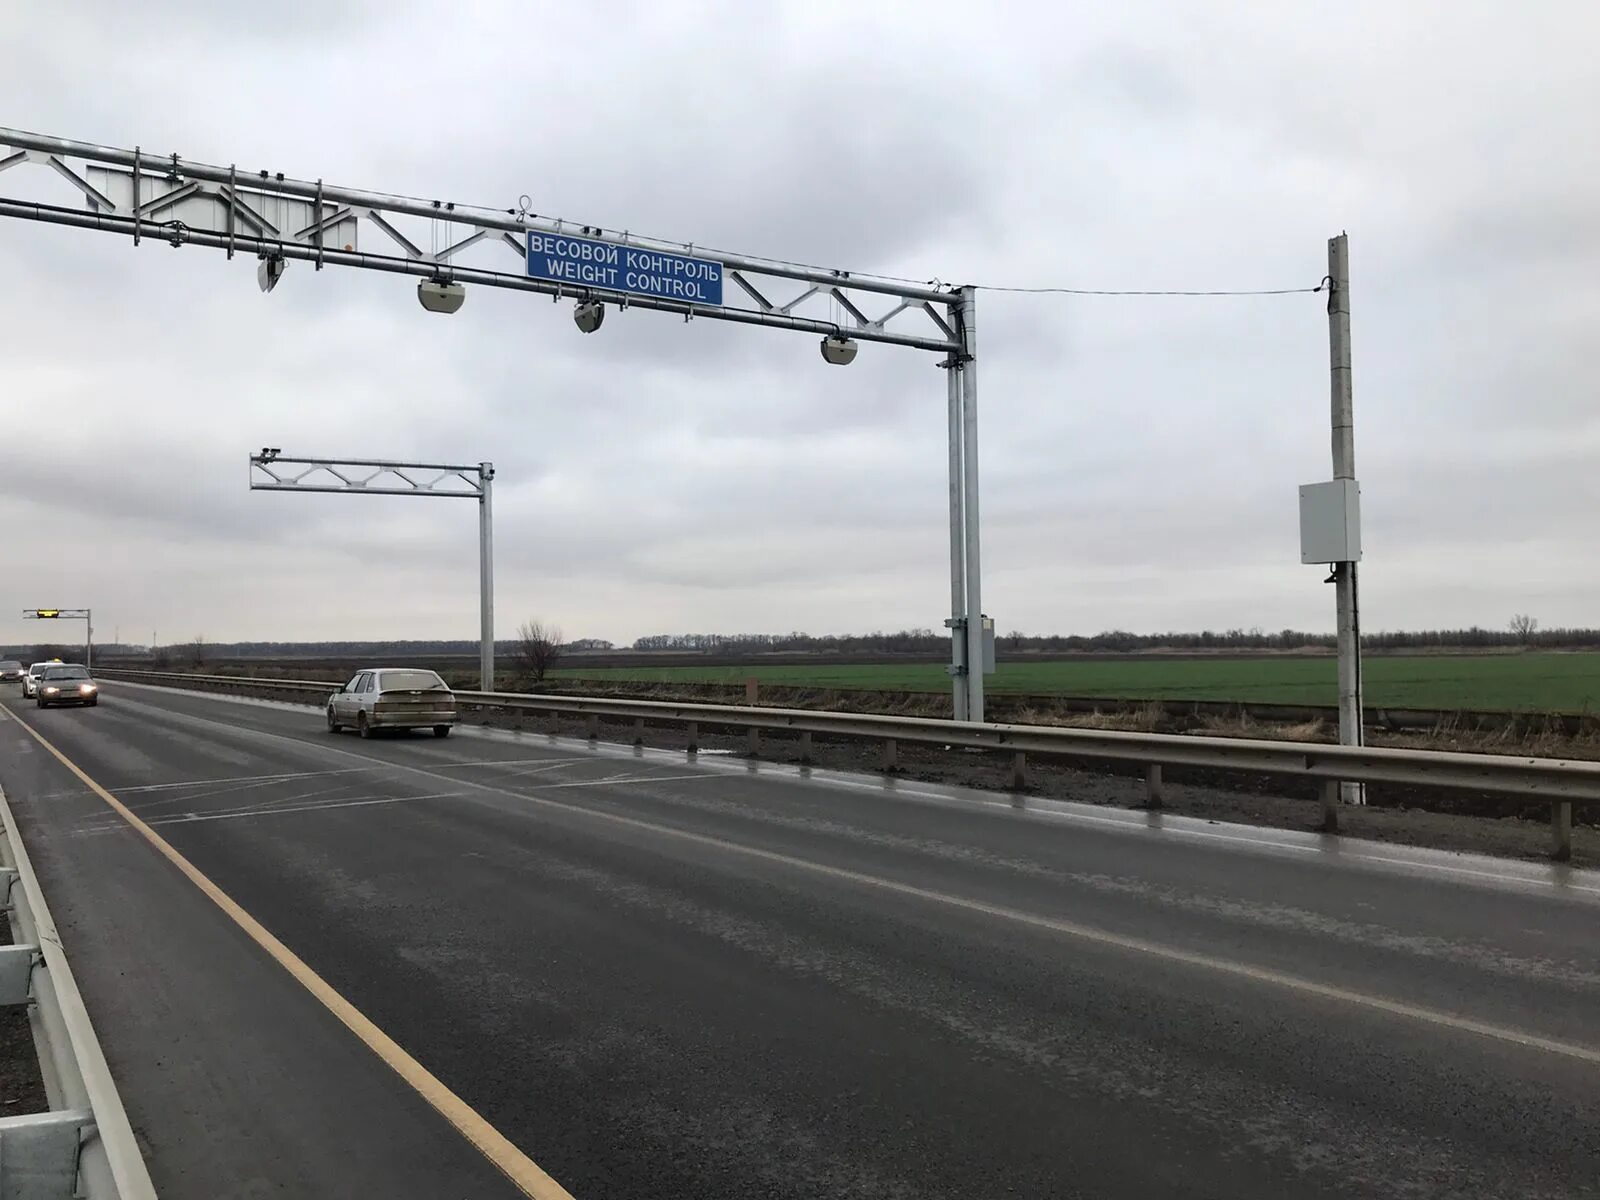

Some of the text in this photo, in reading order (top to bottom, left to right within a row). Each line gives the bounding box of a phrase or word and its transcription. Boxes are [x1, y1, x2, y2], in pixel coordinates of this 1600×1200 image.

[531, 235, 719, 281] ВЕСОВОЙ КОНТРОЛЬ
[547, 259, 706, 299] WEIGHT CONTROL
